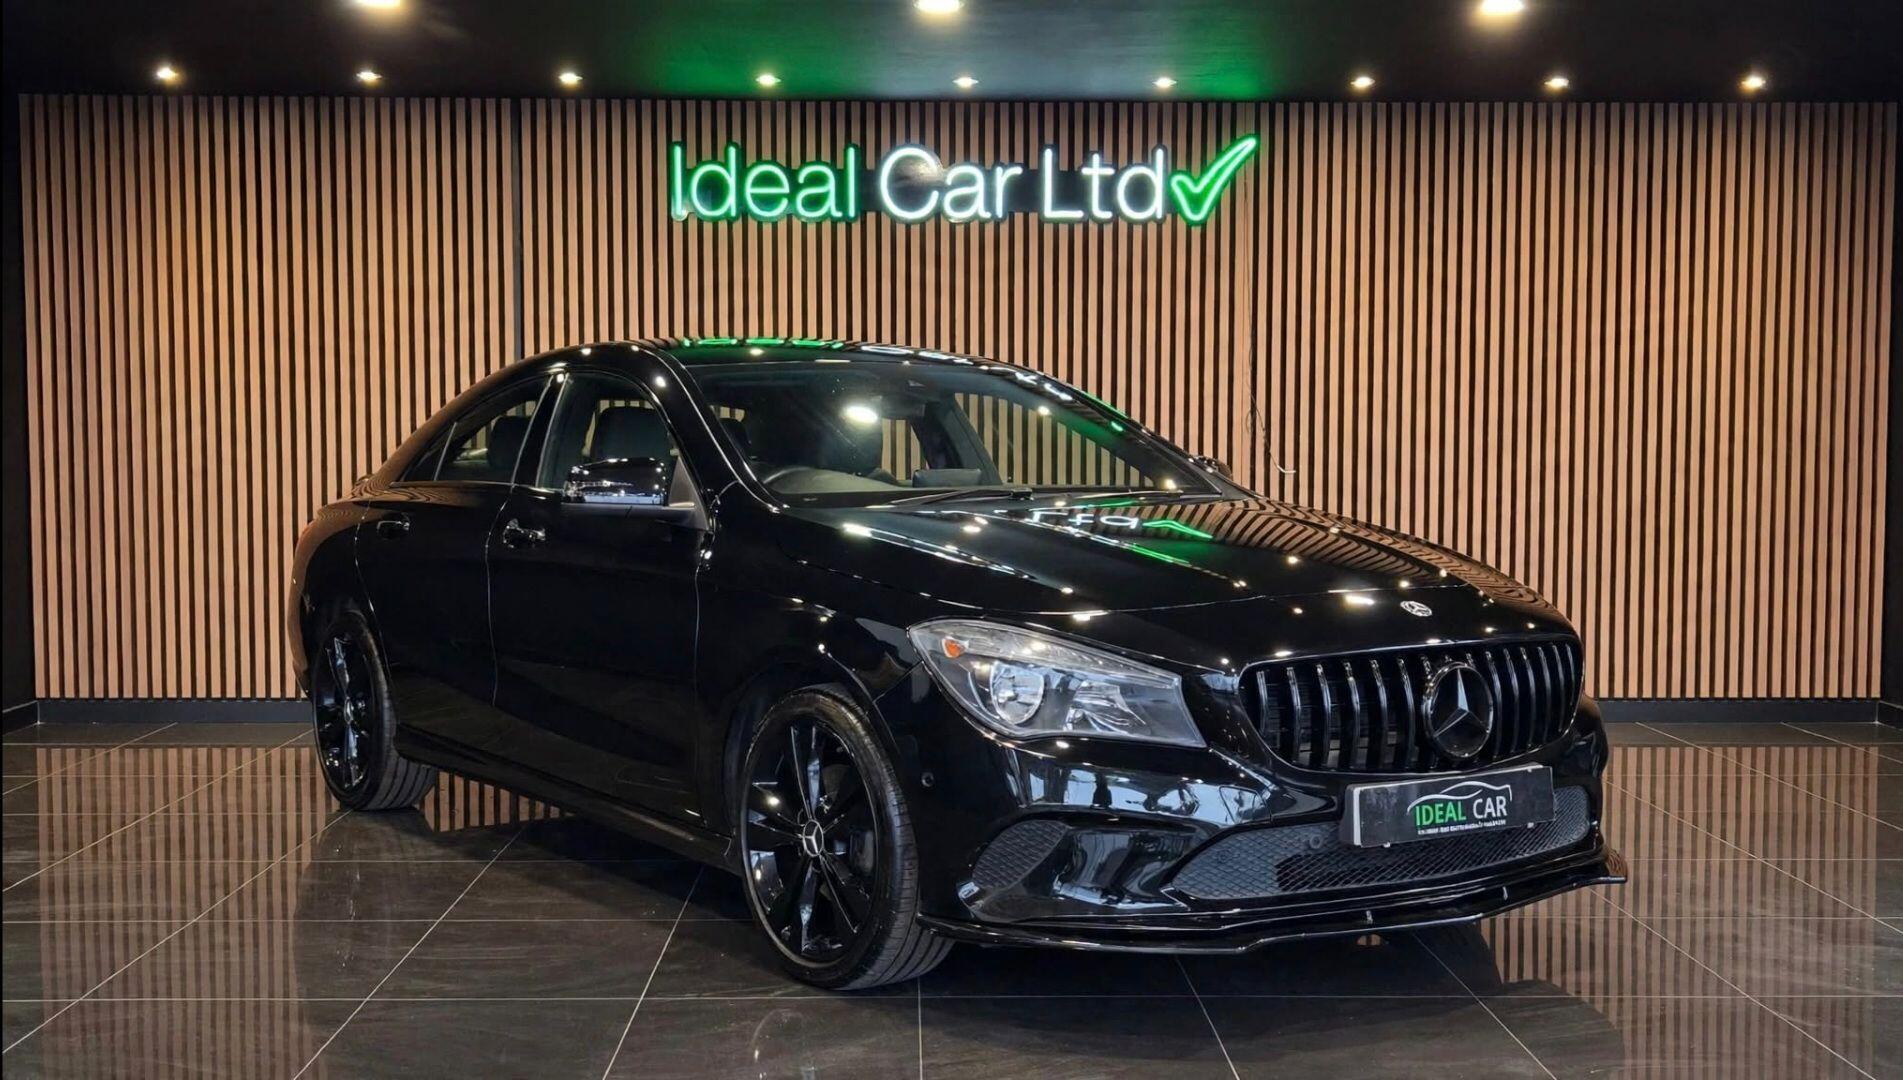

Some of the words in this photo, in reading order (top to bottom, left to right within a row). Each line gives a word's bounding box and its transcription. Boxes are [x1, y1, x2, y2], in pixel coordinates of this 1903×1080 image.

[672, 143, 857, 221] Ideal
[880, 146, 1023, 220] Car
[1043, 147, 1164, 220] Ltd
[1415, 801, 1466, 825] IDEAL
[1473, 796, 1507, 818] CAR
